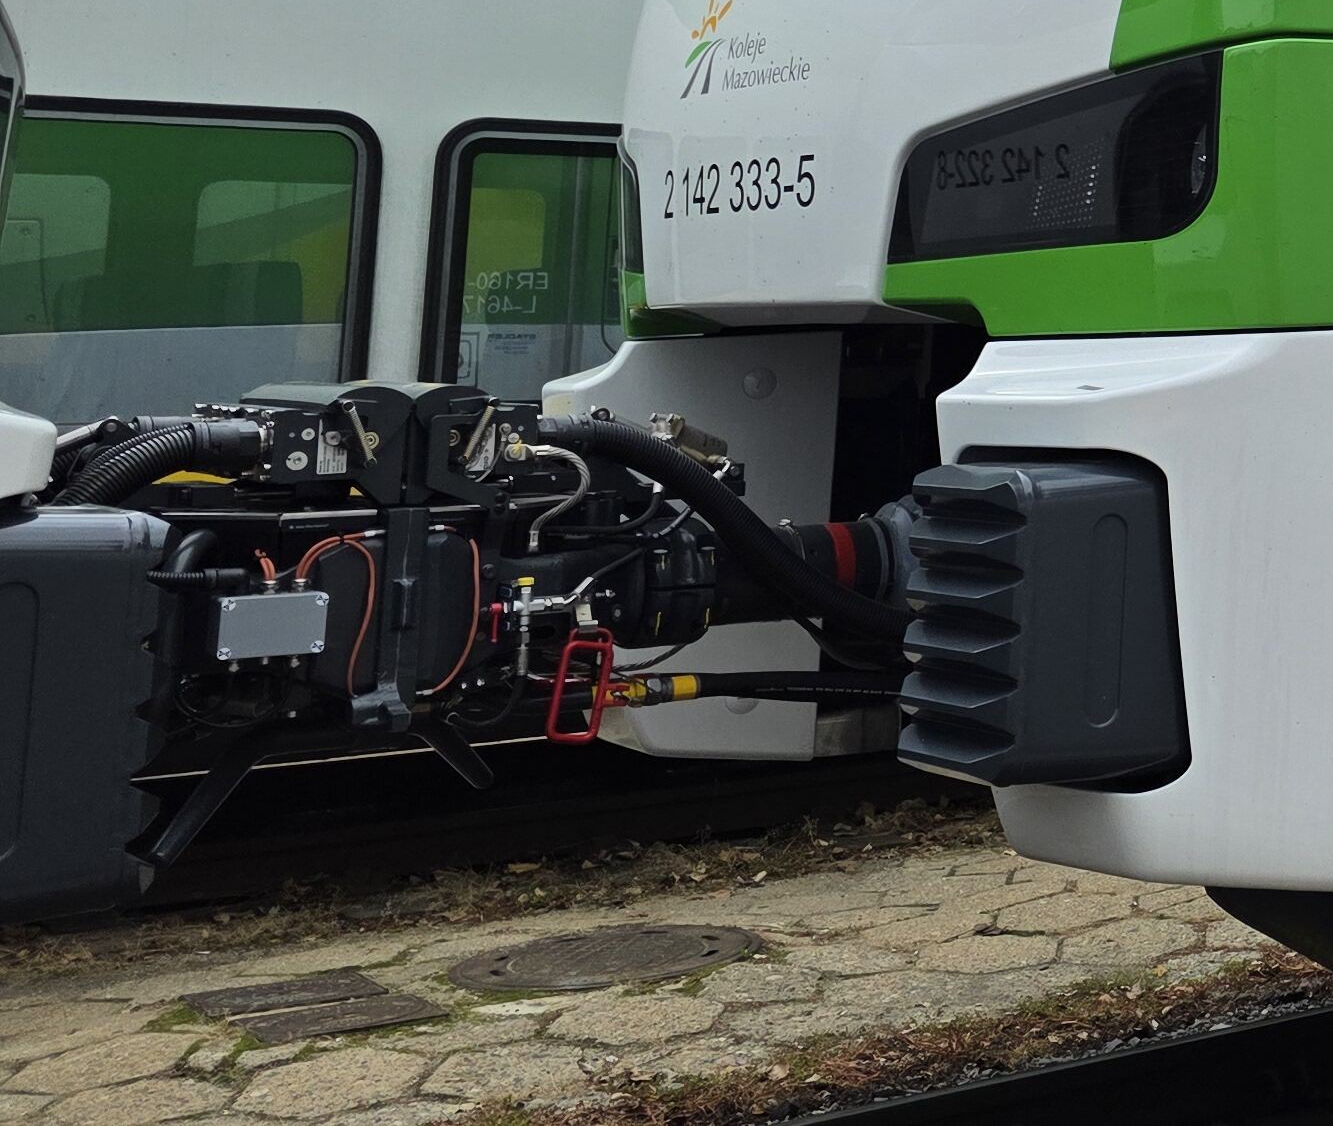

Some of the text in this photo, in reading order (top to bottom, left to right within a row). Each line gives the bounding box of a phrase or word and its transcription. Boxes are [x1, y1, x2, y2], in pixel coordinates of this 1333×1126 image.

[727, 32, 767, 63] Koleje
[721, 56, 811, 91] Mazowieckie
[664, 154, 816, 219] 2 142 333-5
